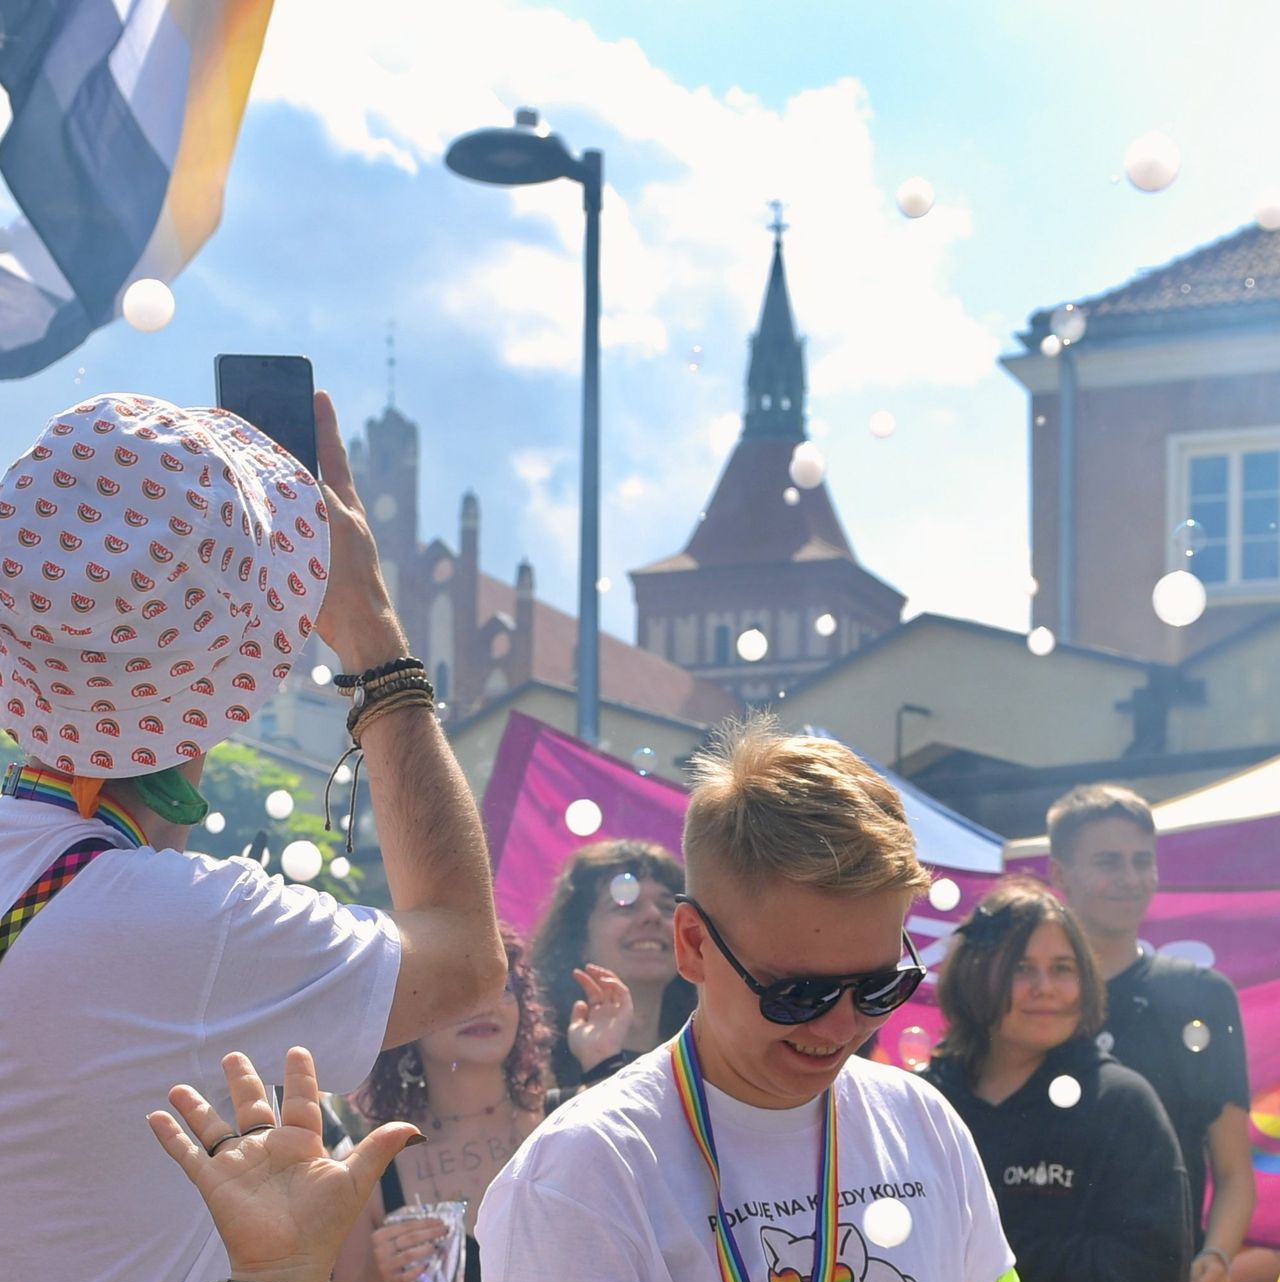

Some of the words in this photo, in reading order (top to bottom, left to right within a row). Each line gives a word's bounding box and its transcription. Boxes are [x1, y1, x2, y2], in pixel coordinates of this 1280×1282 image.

[415, 1137, 510, 1181] LESB
[774, 1198, 805, 1218] NA
[869, 1181, 927, 1202] KOLOR
